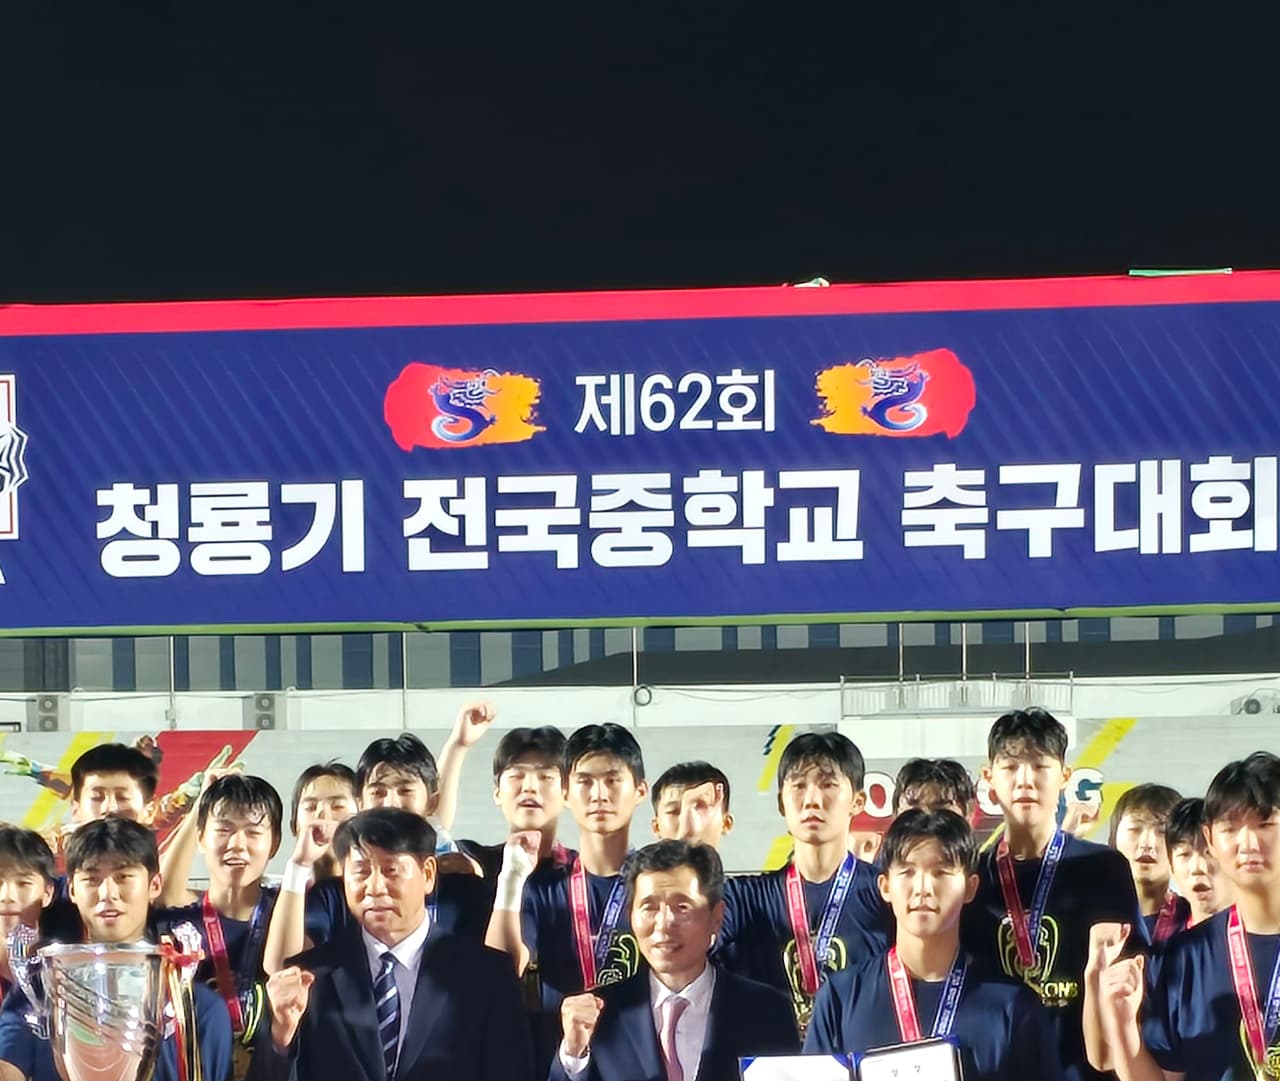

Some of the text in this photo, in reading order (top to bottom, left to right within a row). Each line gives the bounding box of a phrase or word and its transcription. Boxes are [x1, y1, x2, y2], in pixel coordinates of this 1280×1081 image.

[575, 369, 774, 434] 제62회
[96, 456, 1278, 577] 청룡기 전국중학교 축구대회
